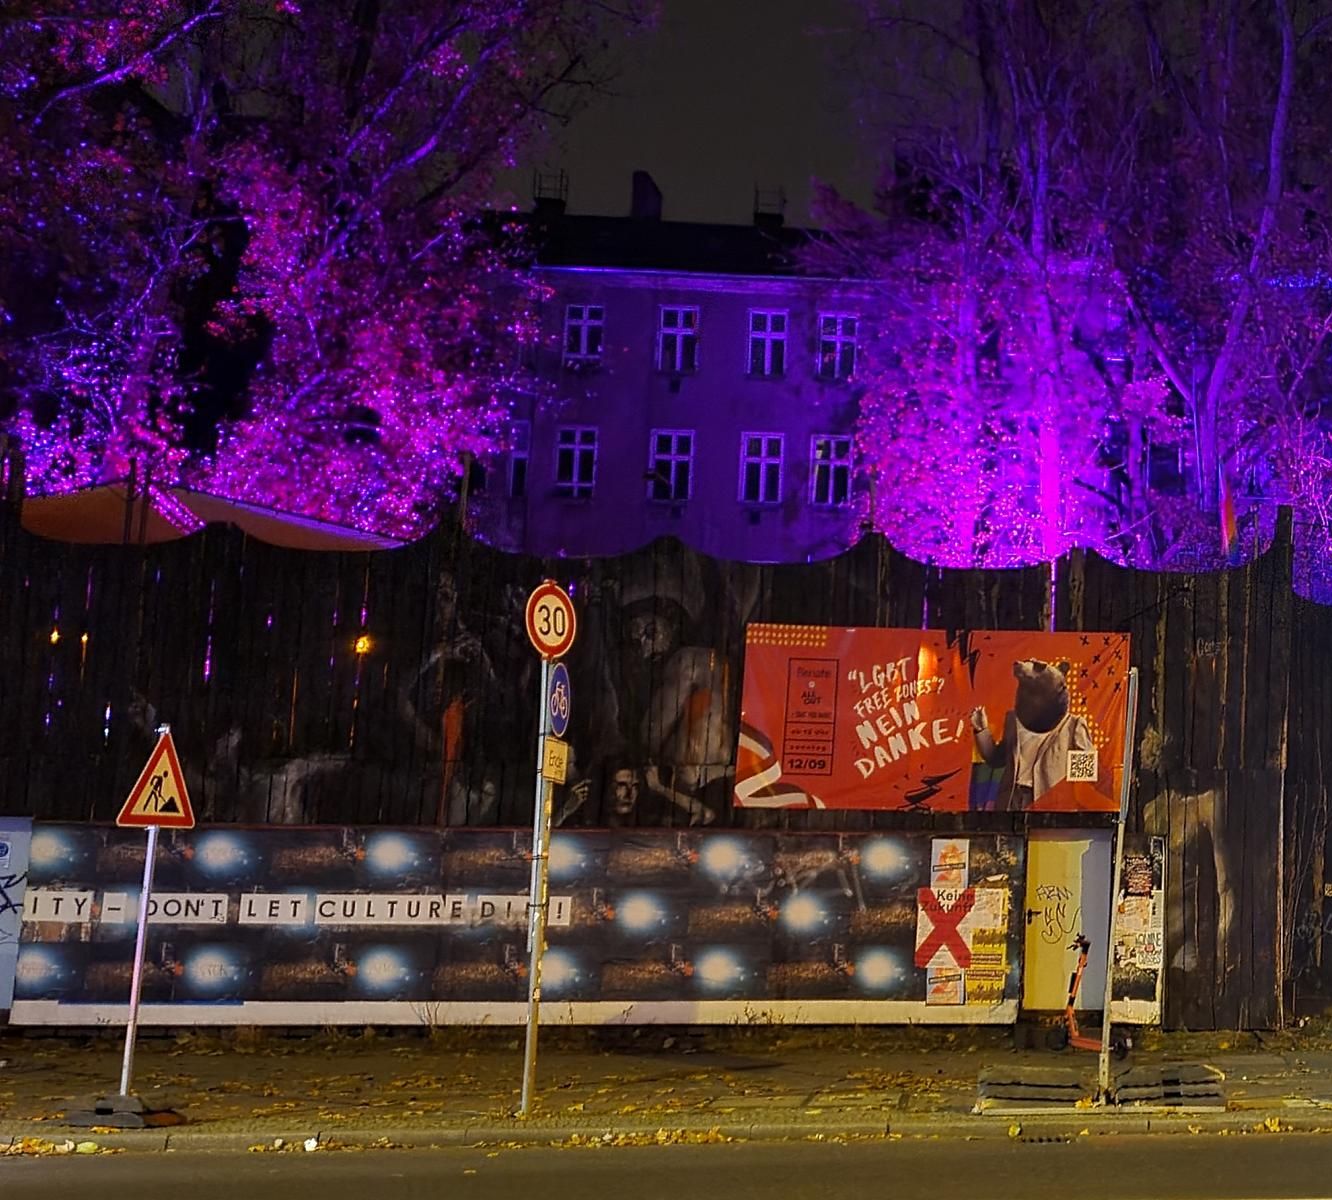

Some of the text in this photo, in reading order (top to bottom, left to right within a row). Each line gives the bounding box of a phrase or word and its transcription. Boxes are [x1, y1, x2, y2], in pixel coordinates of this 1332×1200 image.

[537, 604, 566, 637] 30
[853, 687, 893, 718] FREE
[855, 699, 921, 750] NEIN
[787, 759, 827, 770] 12/09
[853, 718, 965, 780] DANKE!
[247, 899, 301, 918] LET
[318, 900, 463, 918] CULTURE
